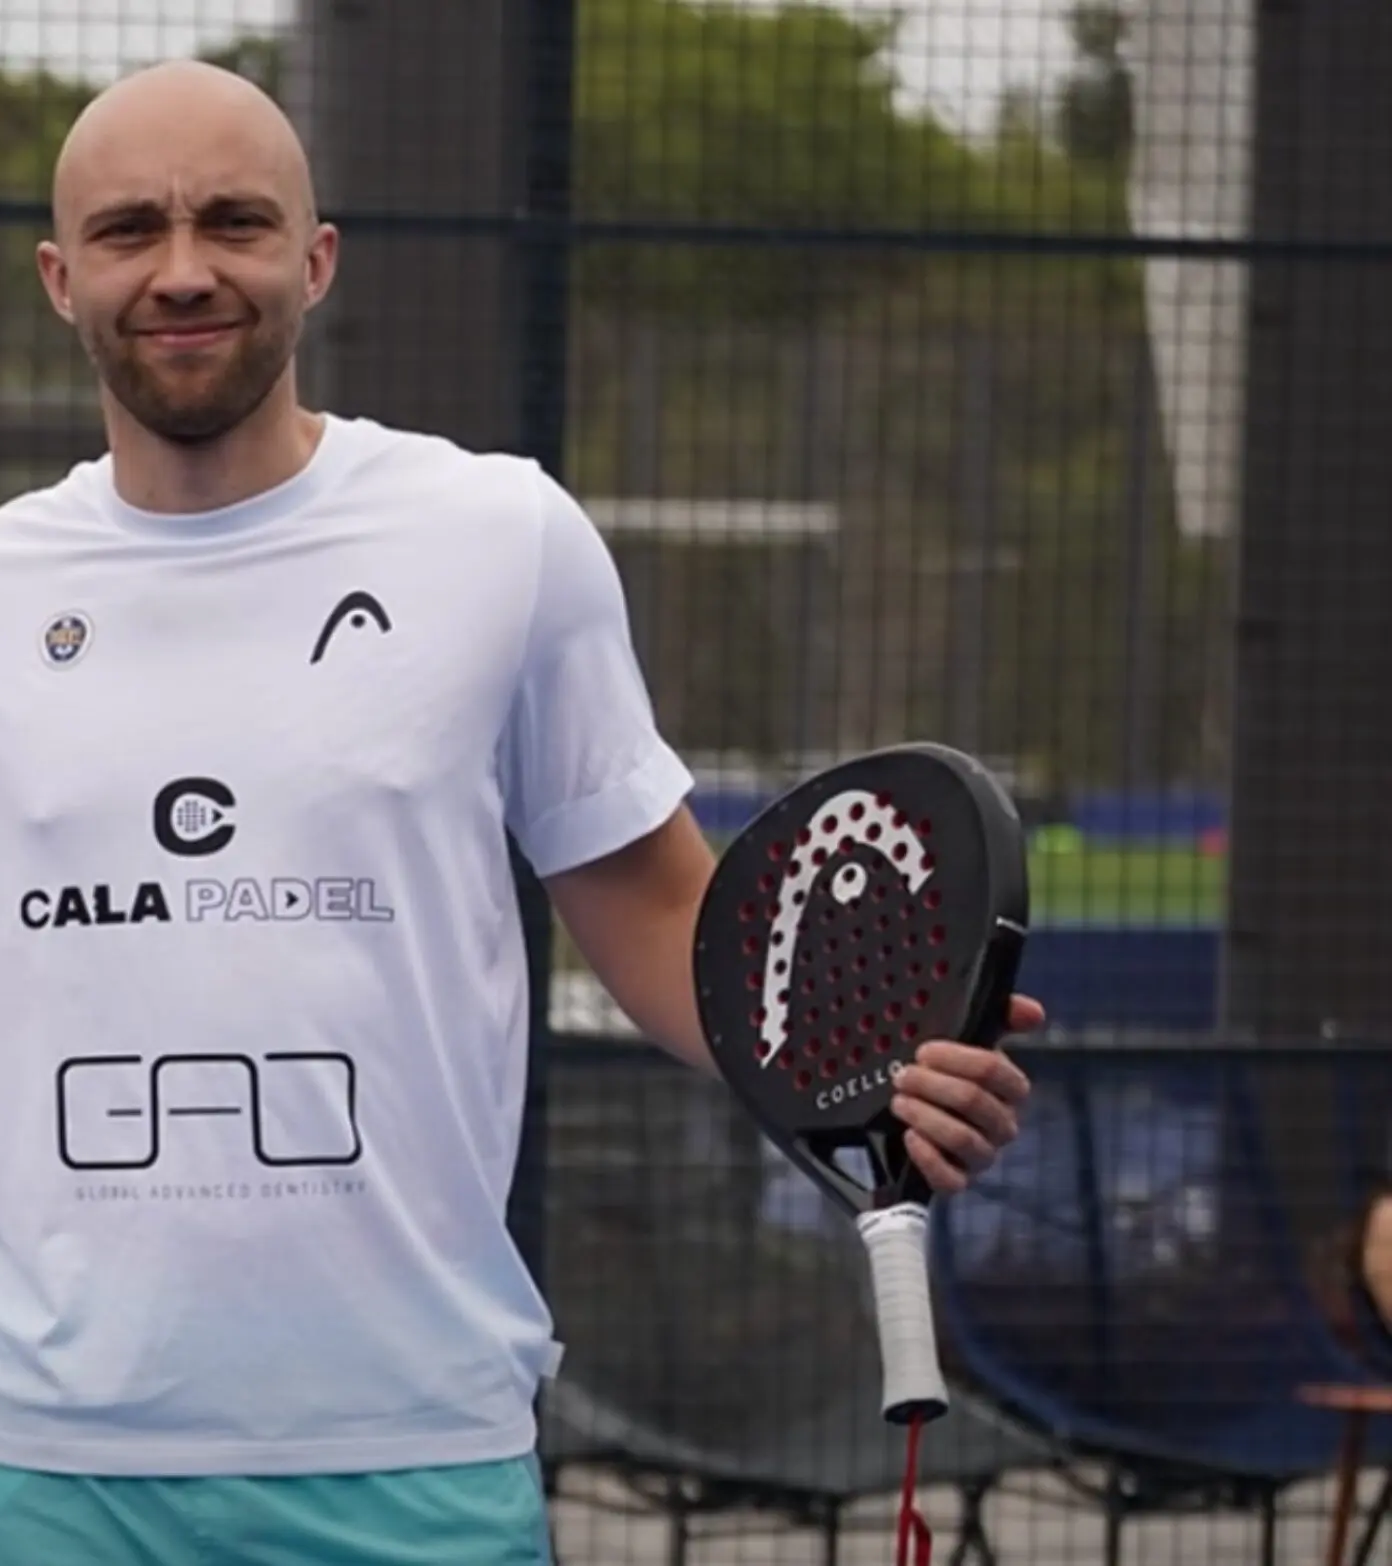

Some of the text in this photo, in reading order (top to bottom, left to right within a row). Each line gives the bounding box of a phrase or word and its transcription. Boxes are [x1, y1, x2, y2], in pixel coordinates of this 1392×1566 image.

[20, 877, 395, 929] CALA PADEL
[815, 1059, 904, 1111] COELLO
[75, 1185, 141, 1201] GLOBAL
[149, 1181, 252, 1200] ADVANCED
